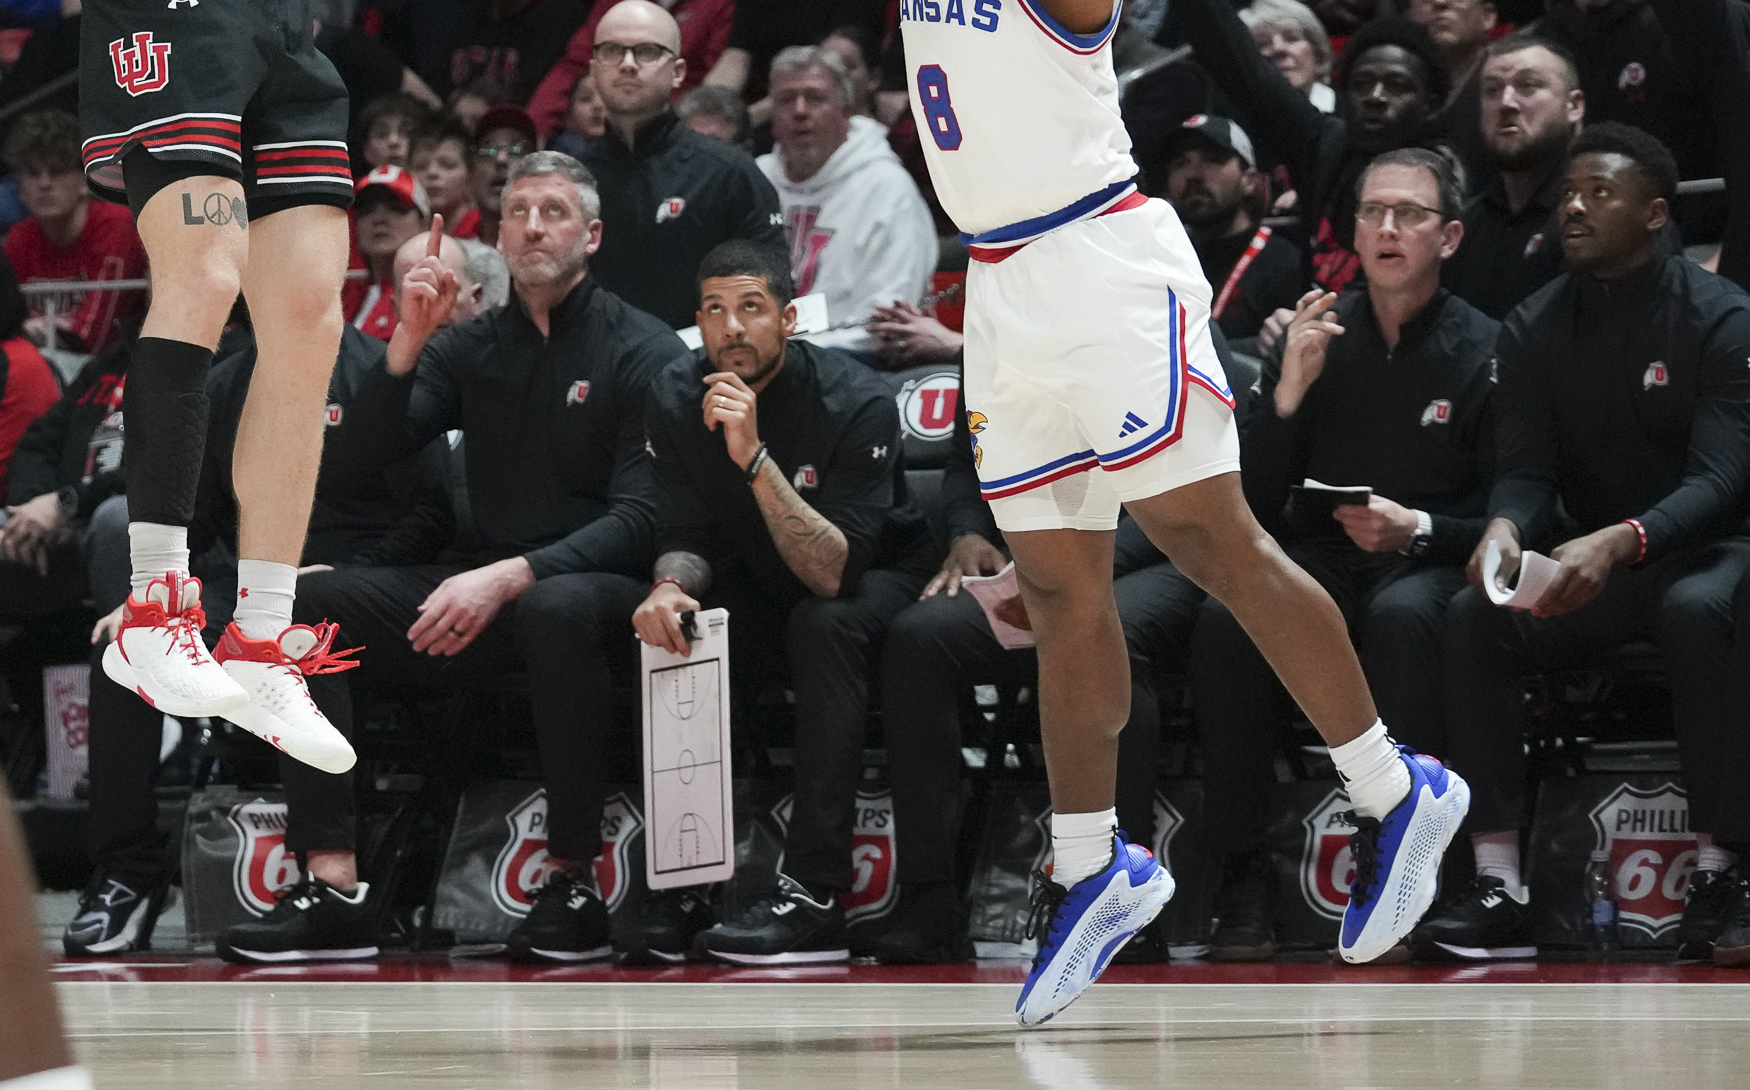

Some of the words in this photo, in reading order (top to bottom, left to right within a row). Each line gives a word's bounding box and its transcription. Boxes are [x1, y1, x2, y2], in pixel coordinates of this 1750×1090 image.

[917, 64, 963, 152] 8
[919, 388, 958, 429] U
[1615, 809, 1687, 833] PHILLI
[1616, 849, 1698, 900] 66
